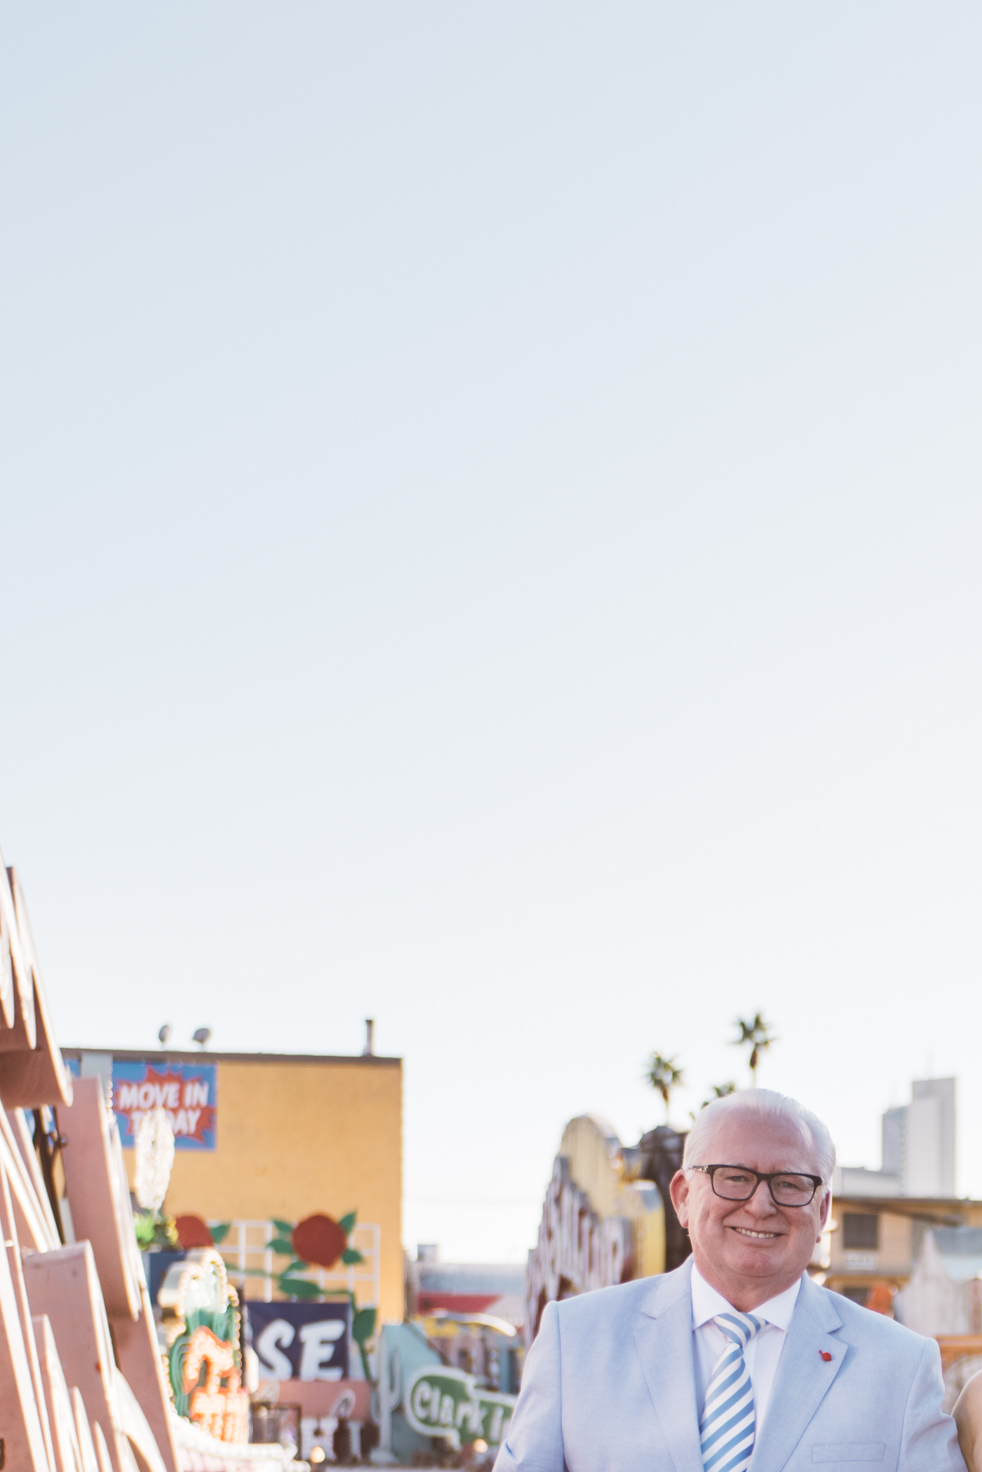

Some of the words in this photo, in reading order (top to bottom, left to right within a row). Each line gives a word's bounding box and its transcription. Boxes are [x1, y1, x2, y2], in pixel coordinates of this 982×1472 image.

[119, 1082, 181, 1109] MOVE
[184, 1081, 210, 1108] IN
[131, 1109, 201, 1136] TAY
[413, 1380, 486, 1436] Clark
